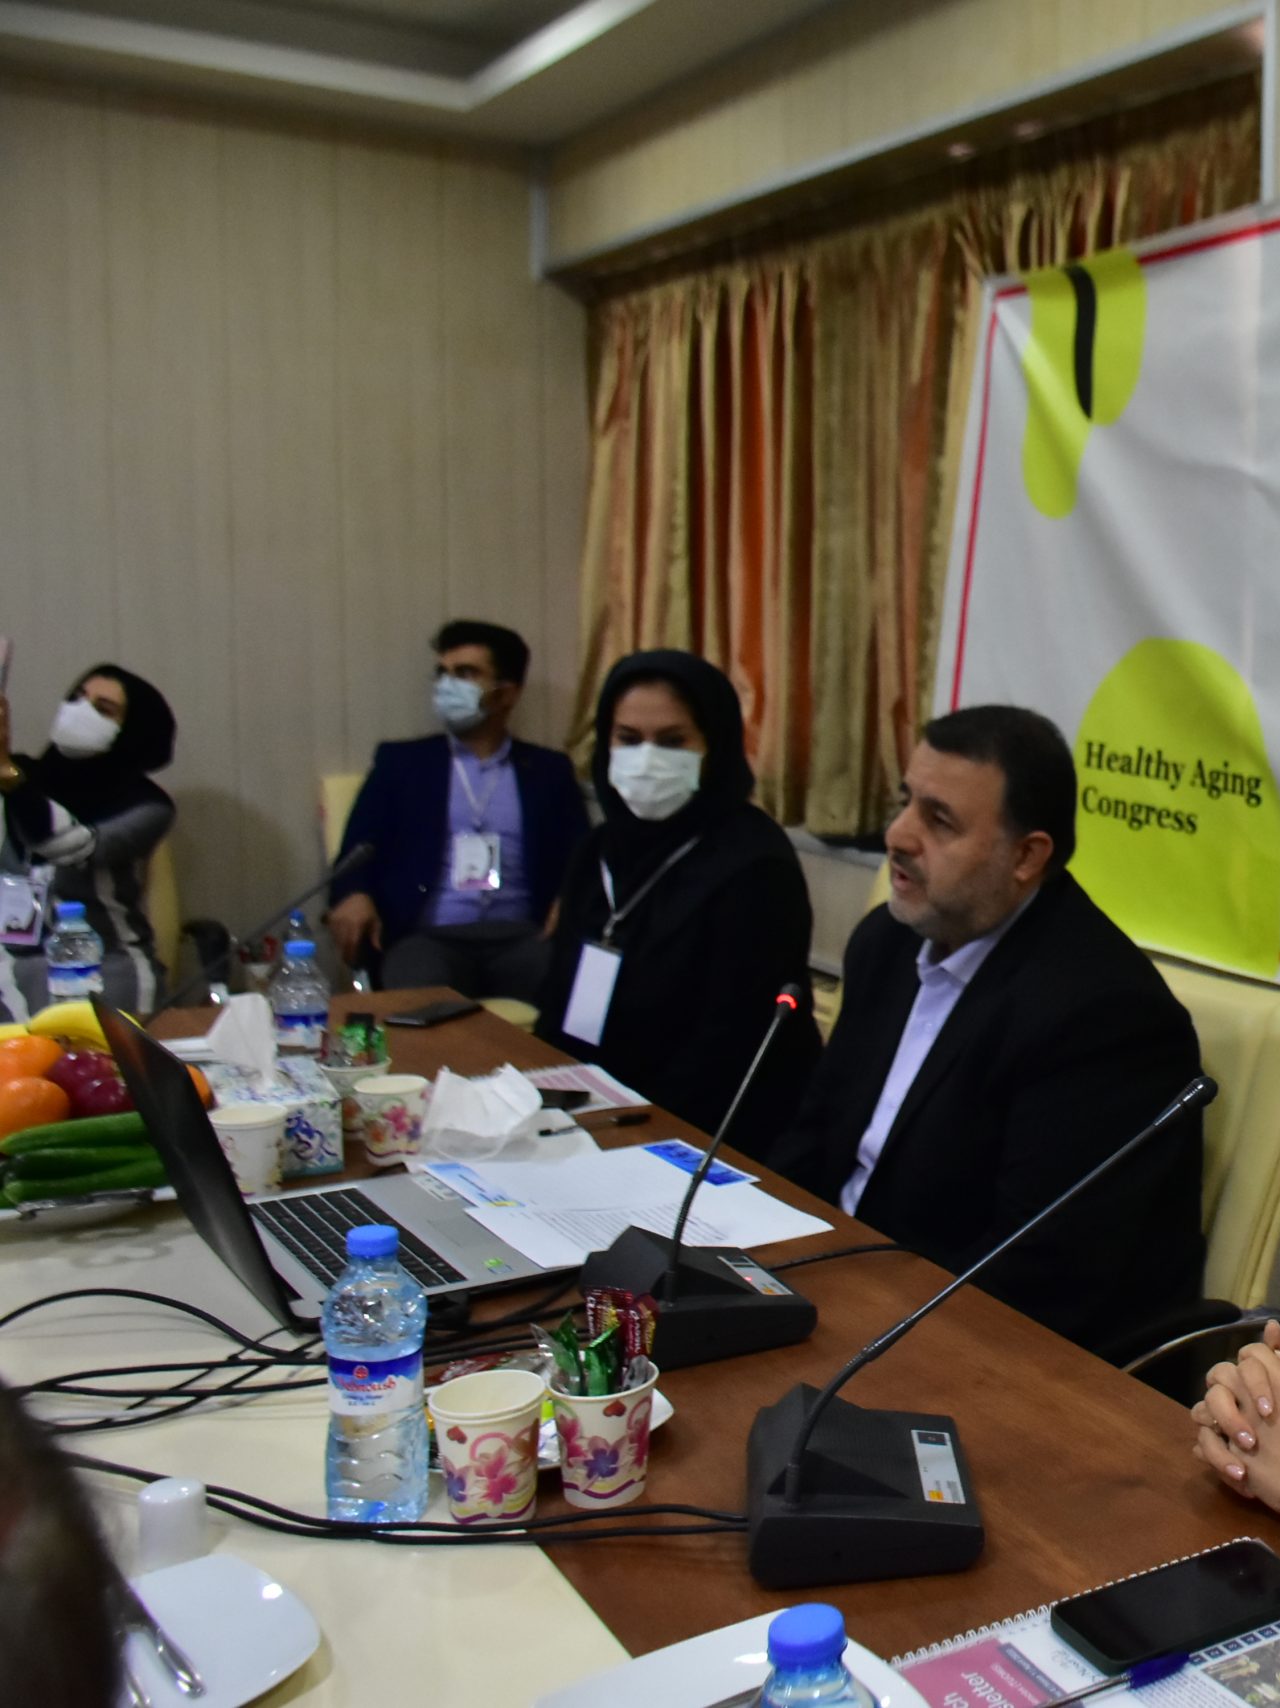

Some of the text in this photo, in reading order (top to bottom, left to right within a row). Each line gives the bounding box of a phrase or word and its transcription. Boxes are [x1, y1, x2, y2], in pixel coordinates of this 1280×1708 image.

[1085, 741, 1263, 808] Healthy Aging
[1082, 786, 1198, 835] Congress
[960, 1671, 1016, 1708] sletter
